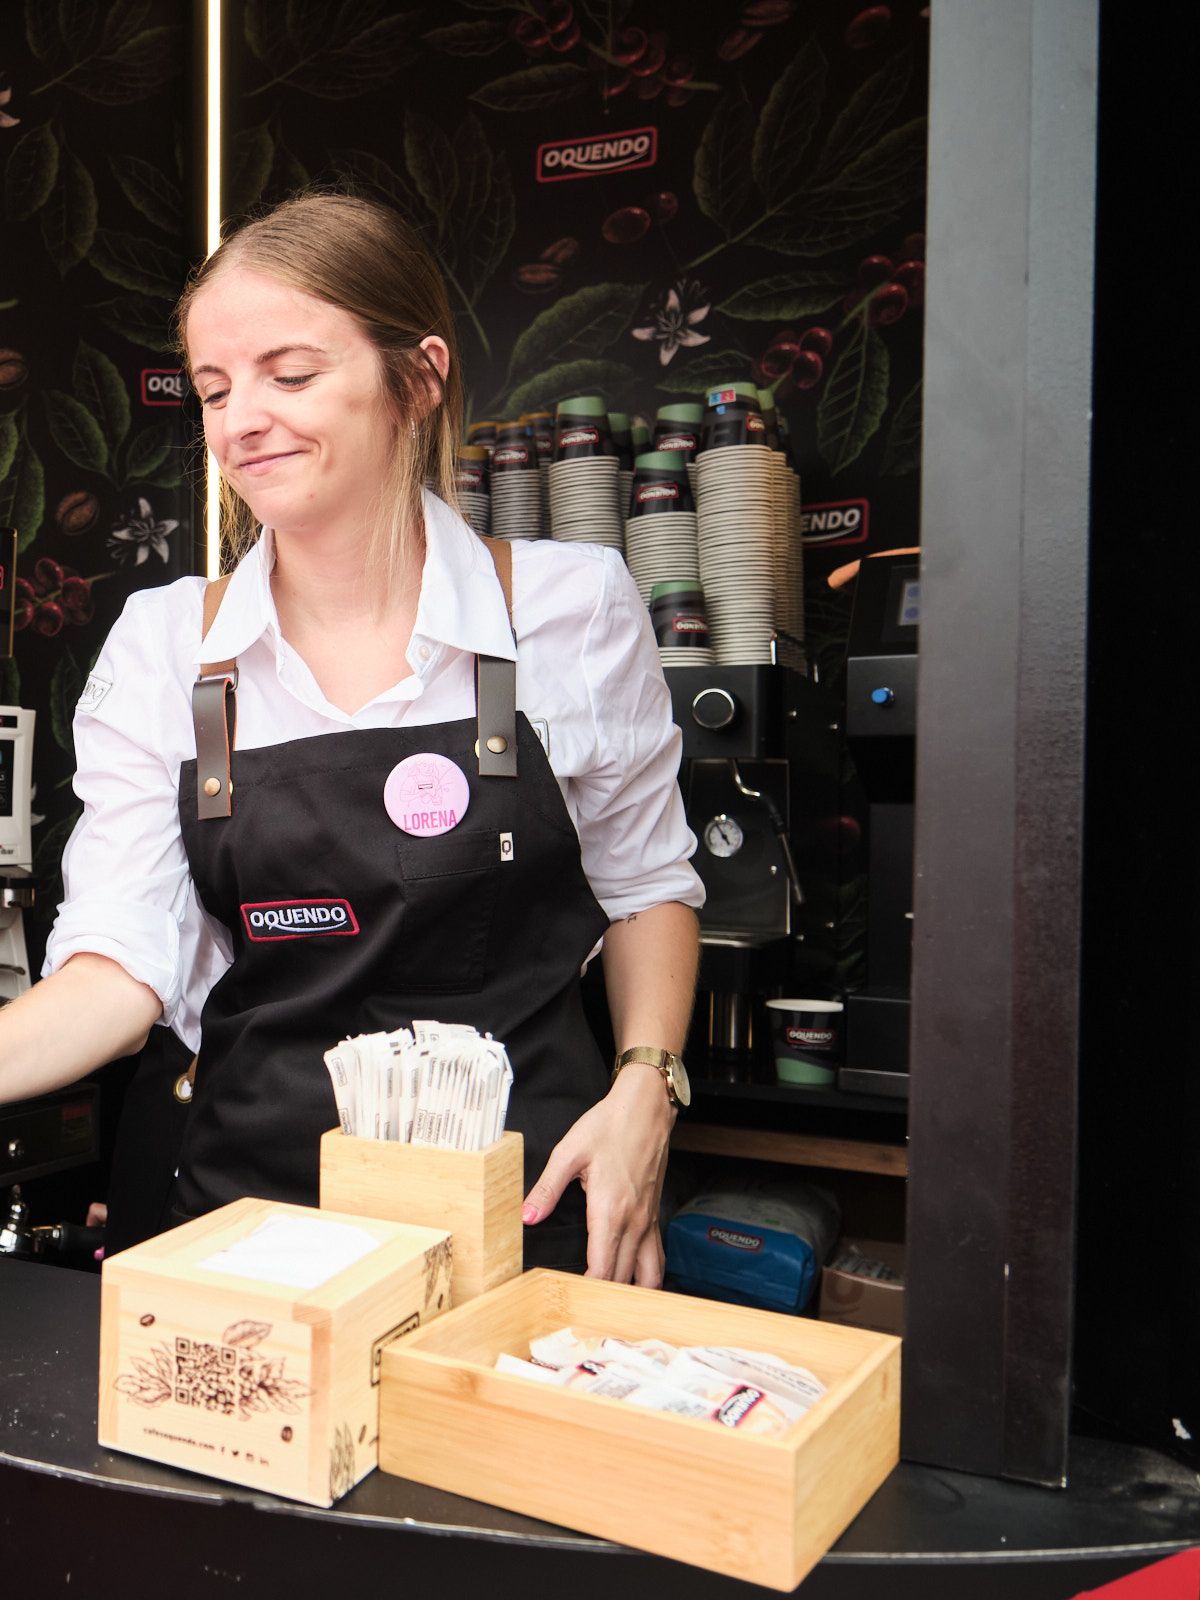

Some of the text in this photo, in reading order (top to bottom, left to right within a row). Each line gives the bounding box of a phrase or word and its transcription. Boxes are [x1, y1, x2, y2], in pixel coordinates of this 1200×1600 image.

[543, 135, 650, 170] OQUENDO
[403, 809, 457, 831] LORENA
[501, 839, 512, 855] Q
[249, 906, 348, 933] OQUENDO
[788, 1030, 833, 1044] OQUENDO
[710, 1227, 761, 1249] OQUENDO
